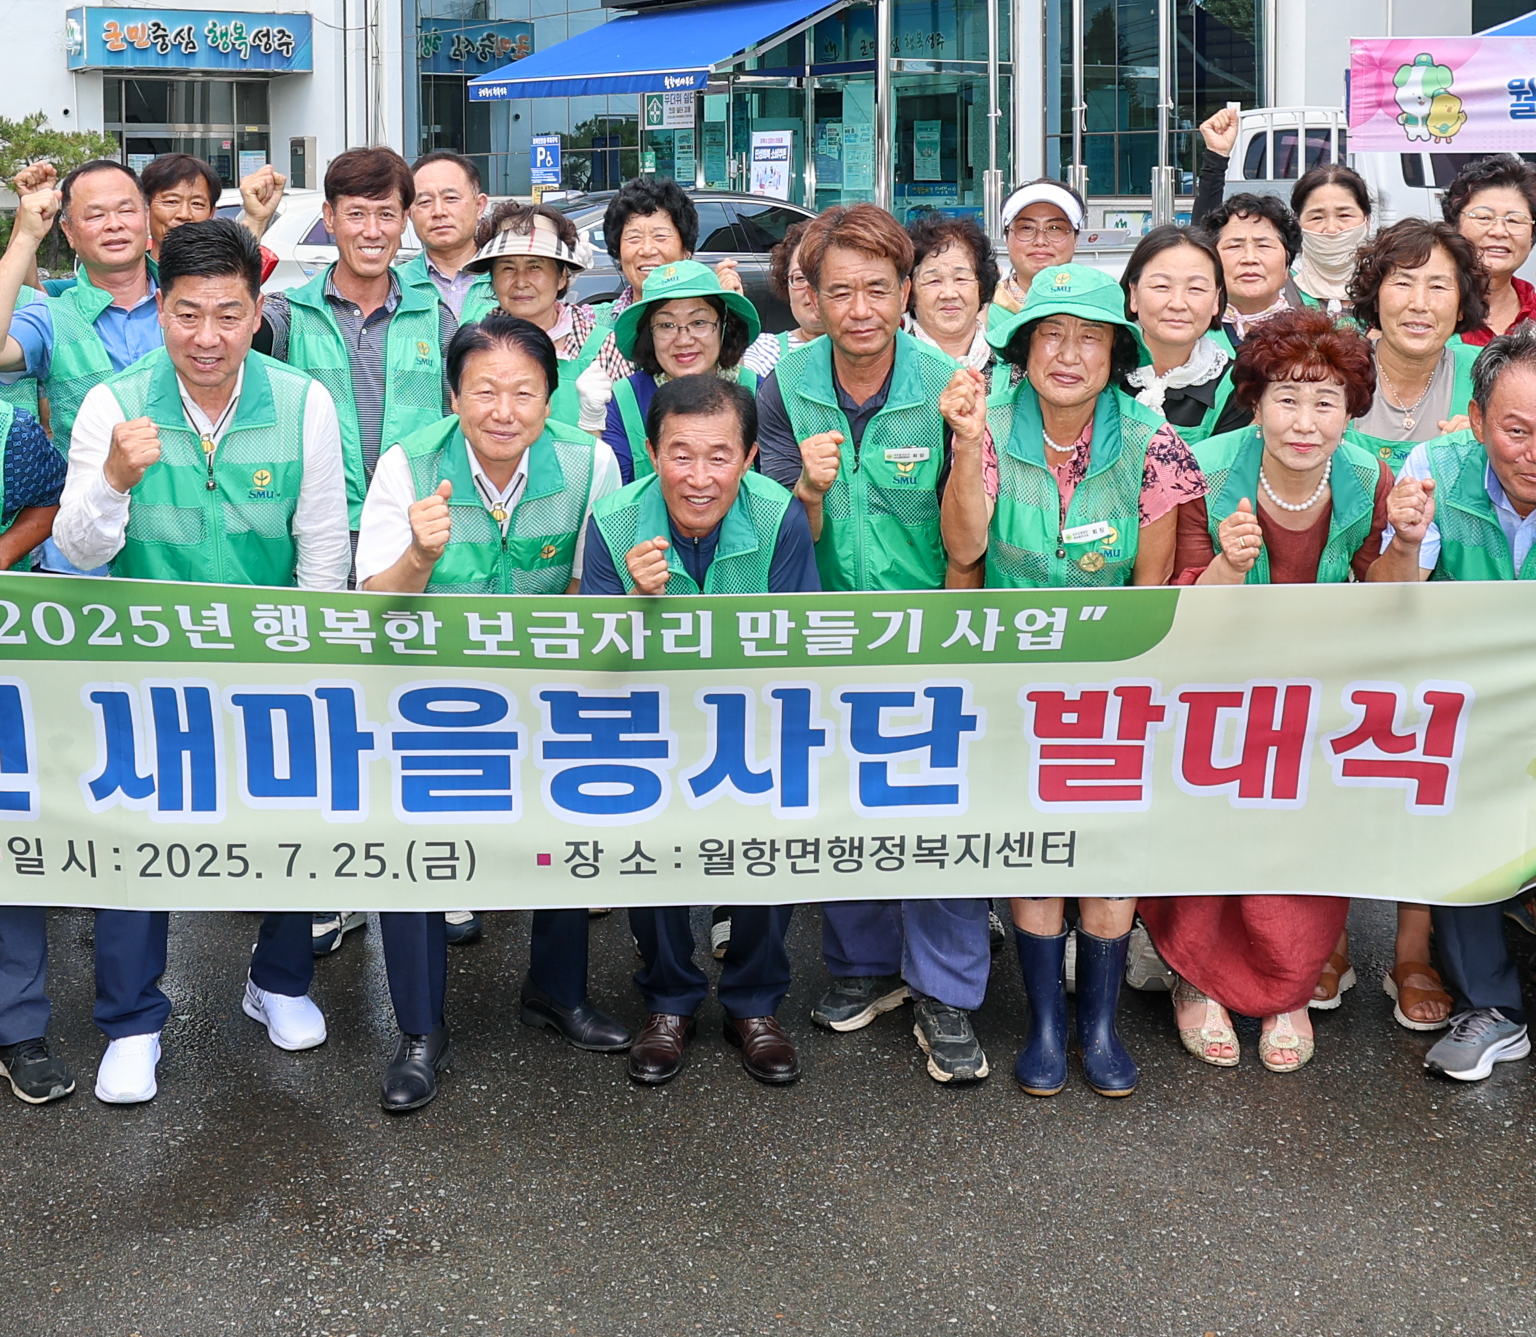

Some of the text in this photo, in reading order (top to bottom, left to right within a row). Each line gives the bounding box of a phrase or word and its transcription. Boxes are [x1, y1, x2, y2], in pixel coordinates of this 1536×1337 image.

[102, 19, 296, 60] 군민중심 행복성주
[248, 490, 275, 499] SMU
[892, 476, 918, 485] SMU
[251, 601, 442, 656] 행복한
[462, 608, 714, 662] 보금자리
[734, 606, 925, 659] 만들기
[89, 684, 978, 816] 새마을봉사단
[1026, 684, 1466, 806] 발대식
[138, 842, 265, 879] 2025.
[697, 830, 1078, 878] 월항면행정복지센터
